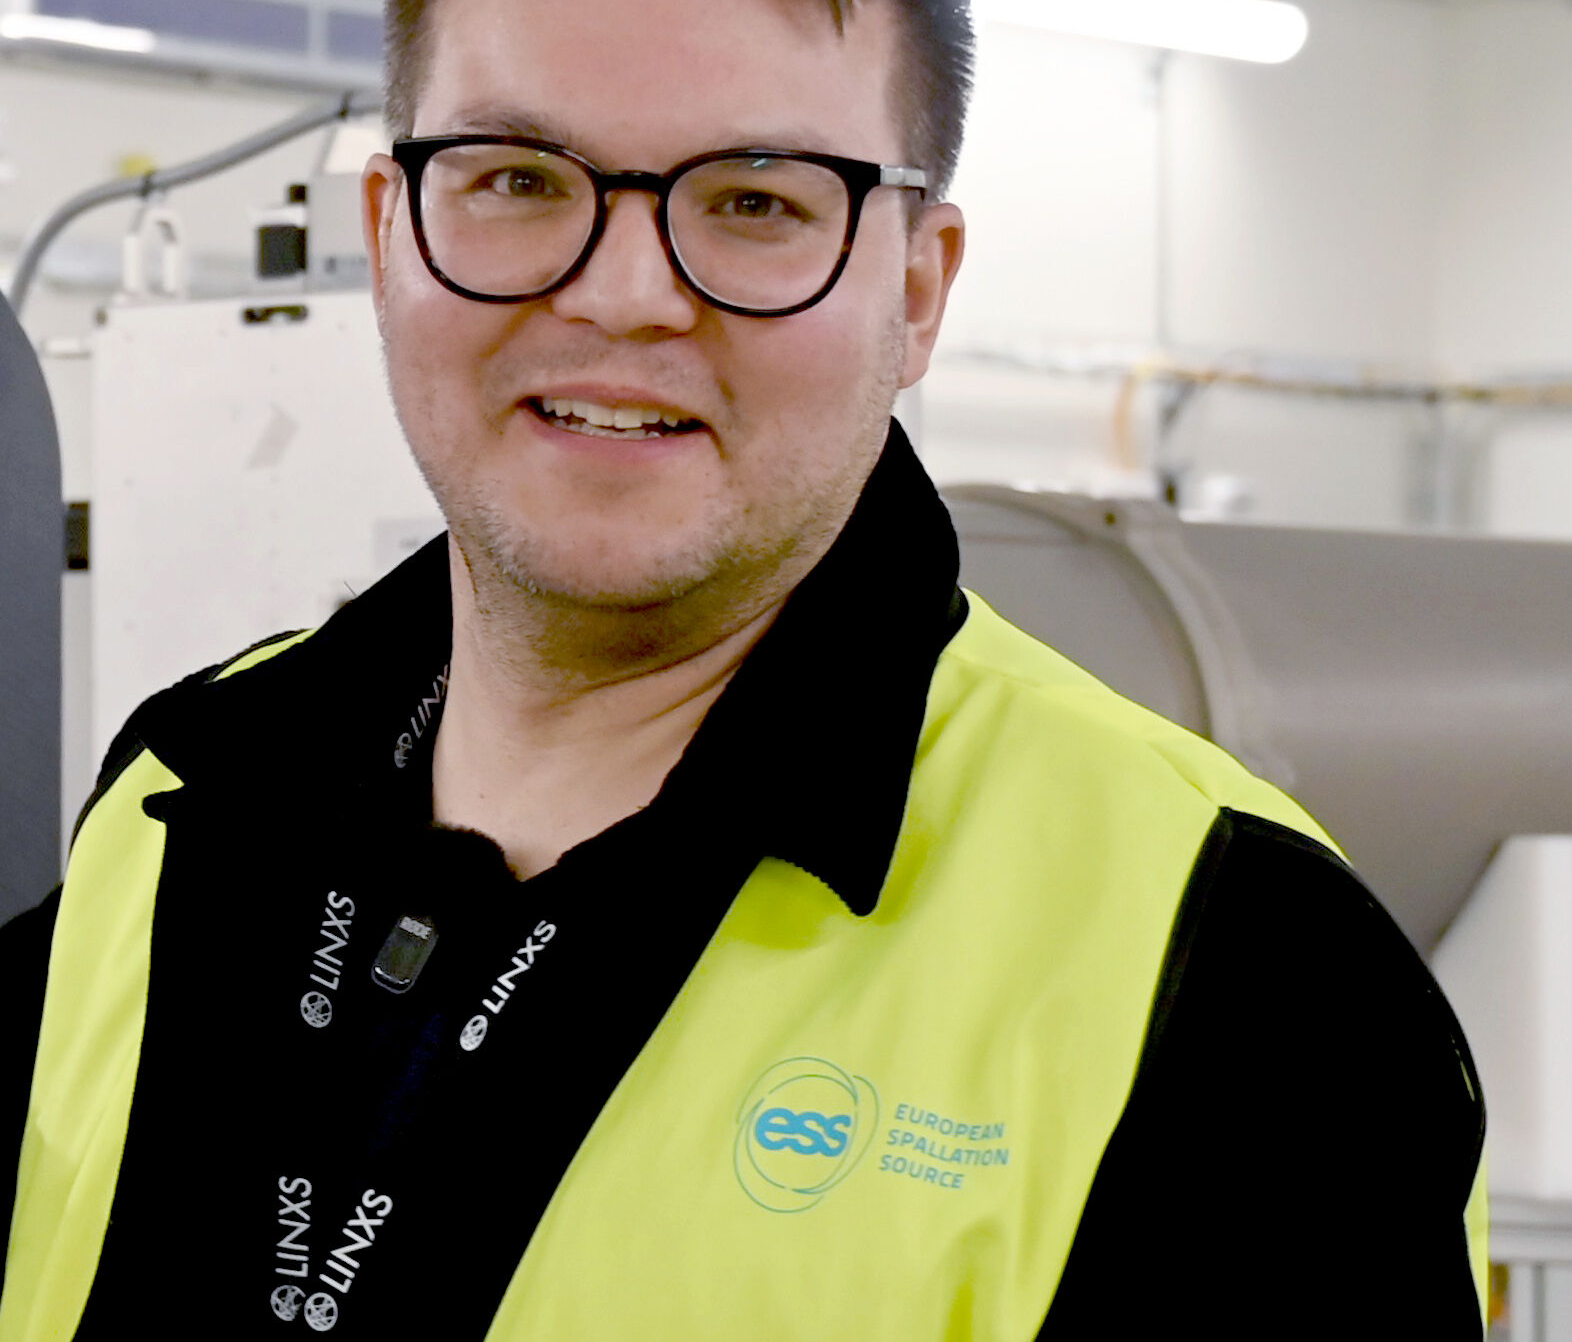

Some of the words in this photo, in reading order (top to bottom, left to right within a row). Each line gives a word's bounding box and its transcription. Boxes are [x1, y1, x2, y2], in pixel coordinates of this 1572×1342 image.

[410, 663, 449, 739] LINX
[309, 890, 356, 991] LINXS
[481, 919, 557, 1014] LINXS
[755, 1107, 853, 1158] ess
[886, 1128, 1010, 1167] SPALLATION
[894, 1103, 1006, 1142] EUROPEAN
[878, 1154, 965, 1190] SOURCE
[274, 1175, 313, 1278] LINXS
[318, 1188, 394, 1294] LINXS
